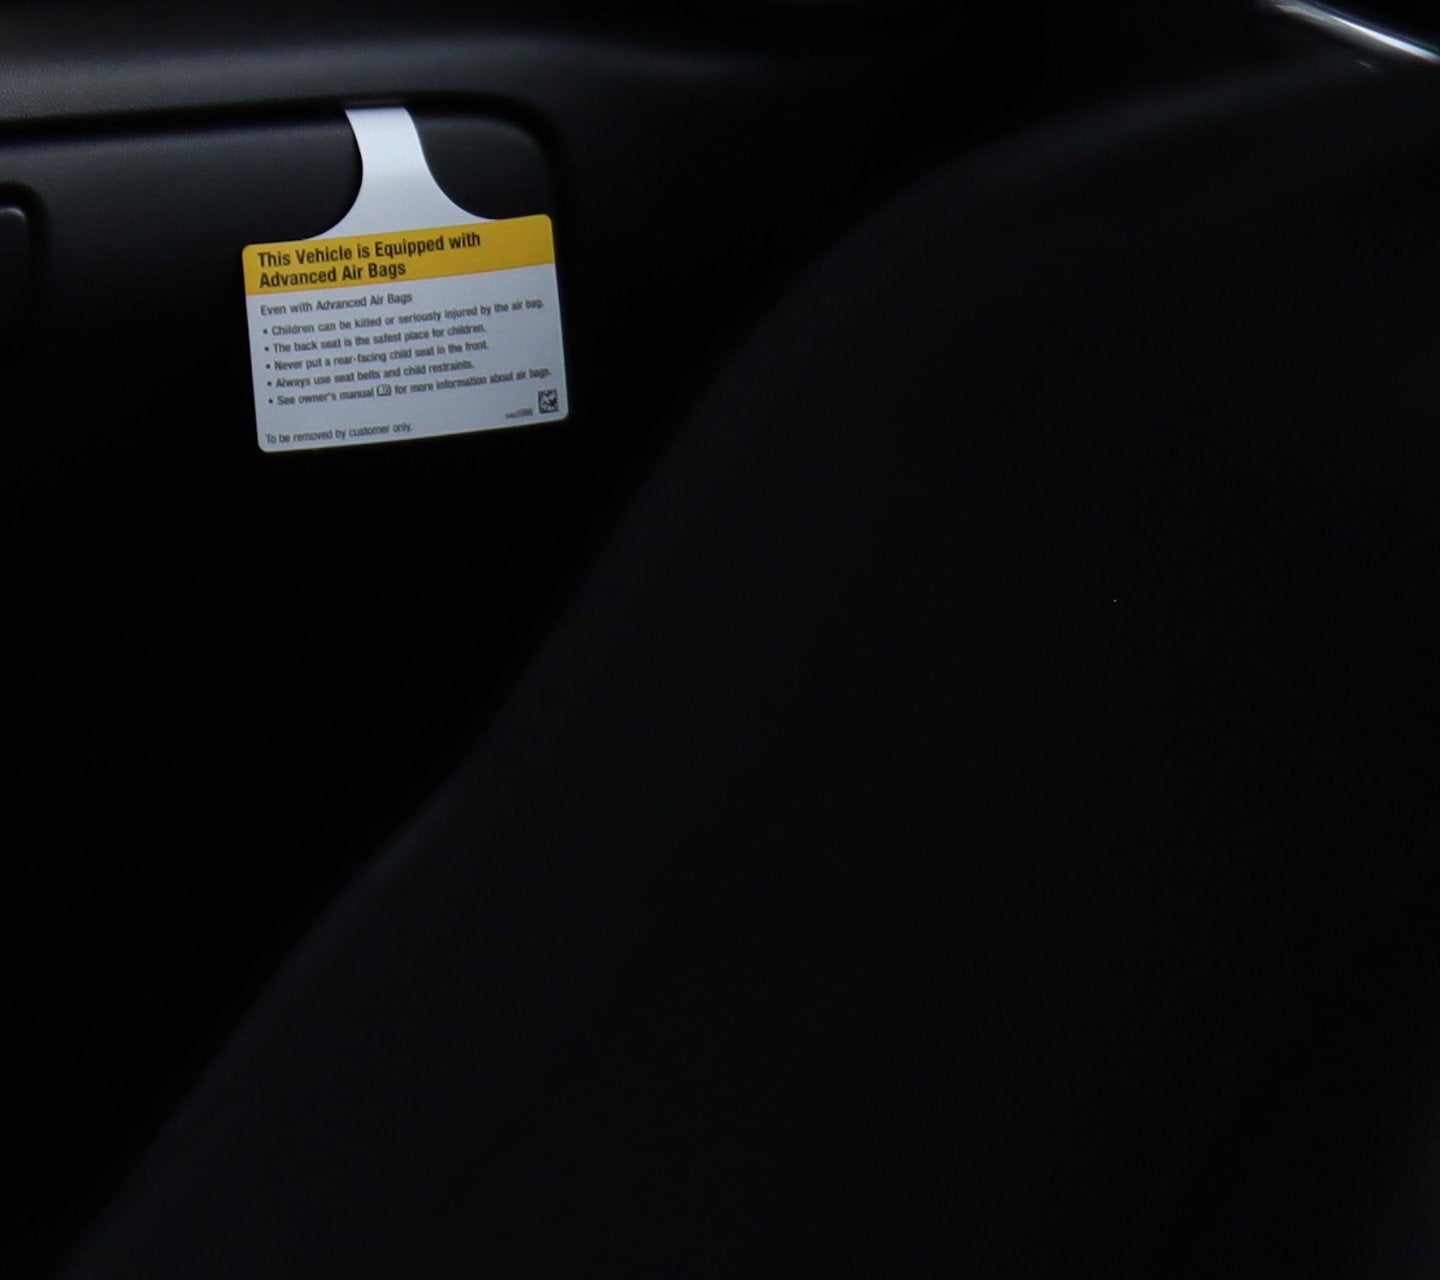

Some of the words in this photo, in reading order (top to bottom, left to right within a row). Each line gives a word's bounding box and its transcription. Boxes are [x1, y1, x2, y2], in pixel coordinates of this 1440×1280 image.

[257, 251, 292, 268] This
[295, 244, 353, 265] Vehicle
[356, 244, 370, 259] is
[374, 236, 445, 258] Equipped
[448, 231, 481, 249] with
[259, 267, 338, 289] Advanced
[341, 264, 364, 281] Air
[367, 262, 407, 280] Bags
[261, 304, 287, 316] Even
[290, 301, 313, 314] with
[316, 297, 368, 311] Advanced
[370, 295, 384, 306] Air
[387, 293, 413, 305] Bags
[271, 325, 315, 336] Children
[317, 321, 336, 332] can
[340, 319, 352, 330] be
[354, 317, 382, 329] killed
[385, 317, 395, 326] or
[398, 311, 442, 324] seriously
[444, 306, 478, 320] injured
[480, 304, 492, 316] by
[494, 302, 510, 314] the
[511, 300, 524, 311] air
[525, 298, 545, 309] bag.
[273, 343, 292, 354] The
[294, 340, 318, 351] back
[321, 339, 342, 349] seat
[343, 336, 353, 347] is
[354, 335, 371, 346] the
[373, 332, 402, 344] safest
[404, 329, 430, 342] place
[432, 327, 445, 338] for
[447, 324, 487, 337] children.
[274, 360, 304, 371] Never
[306, 357, 323, 370] put
[325, 358, 331, 367] a
[333, 352, 388, 366] rear-facing
[389, 348, 413, 360] child
[415, 346, 435, 357] seat
[436, 344, 446, 355] in
[447, 342, 463, 353] the
[465, 340, 488, 352] front.
[276, 376, 312, 389] Always
[314, 375, 332, 385] use
[334, 372, 356, 383] seat
[357, 369, 381, 381] belts
[383, 367, 402, 379] and
[403, 364, 427, 376] child
[428, 359, 475, 373] restraints.
[276, 395, 296, 406] See
[298, 391, 338, 404] owner's
[339, 388, 375, 400] manual
[394, 384, 408, 395] for
[410, 382, 435, 393] more
[436, 376, 488, 390] information
[489, 372, 515, 384] about
[516, 369, 527, 380] air
[528, 367, 552, 379] bags.
[266, 432, 277, 444] To
[279, 432, 291, 444] be
[293, 429, 333, 442] removed
[335, 426, 347, 439] by
[349, 424, 390, 438] customer
[392, 421, 414, 434] only.
